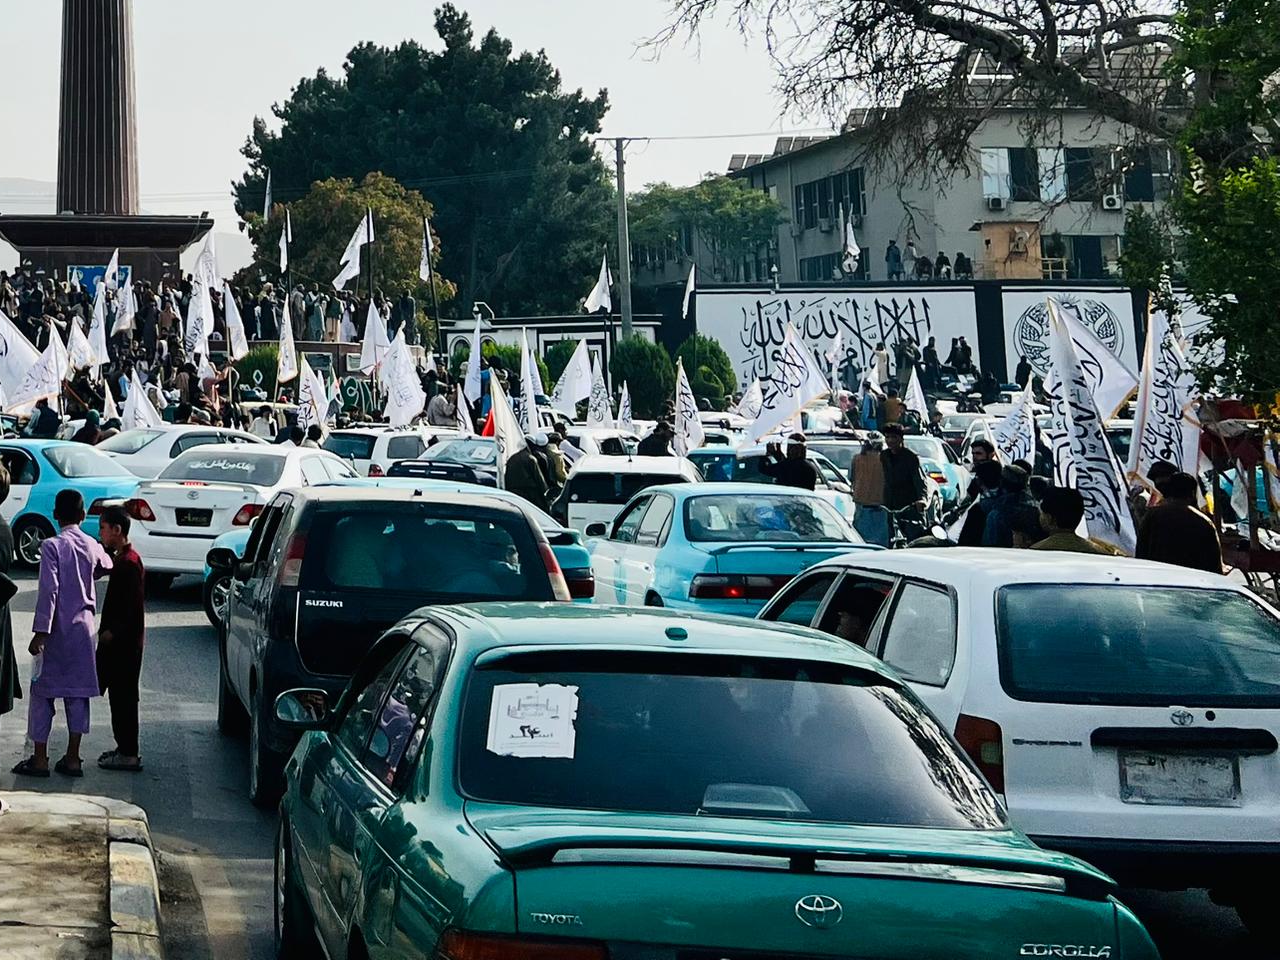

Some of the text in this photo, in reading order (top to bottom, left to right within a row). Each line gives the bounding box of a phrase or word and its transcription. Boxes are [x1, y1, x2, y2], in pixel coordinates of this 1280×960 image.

[305, 599, 344, 608] SUZUKI
[530, 912, 584, 926] TOYOTA
[1020, 943, 1112, 959] COROLLA
